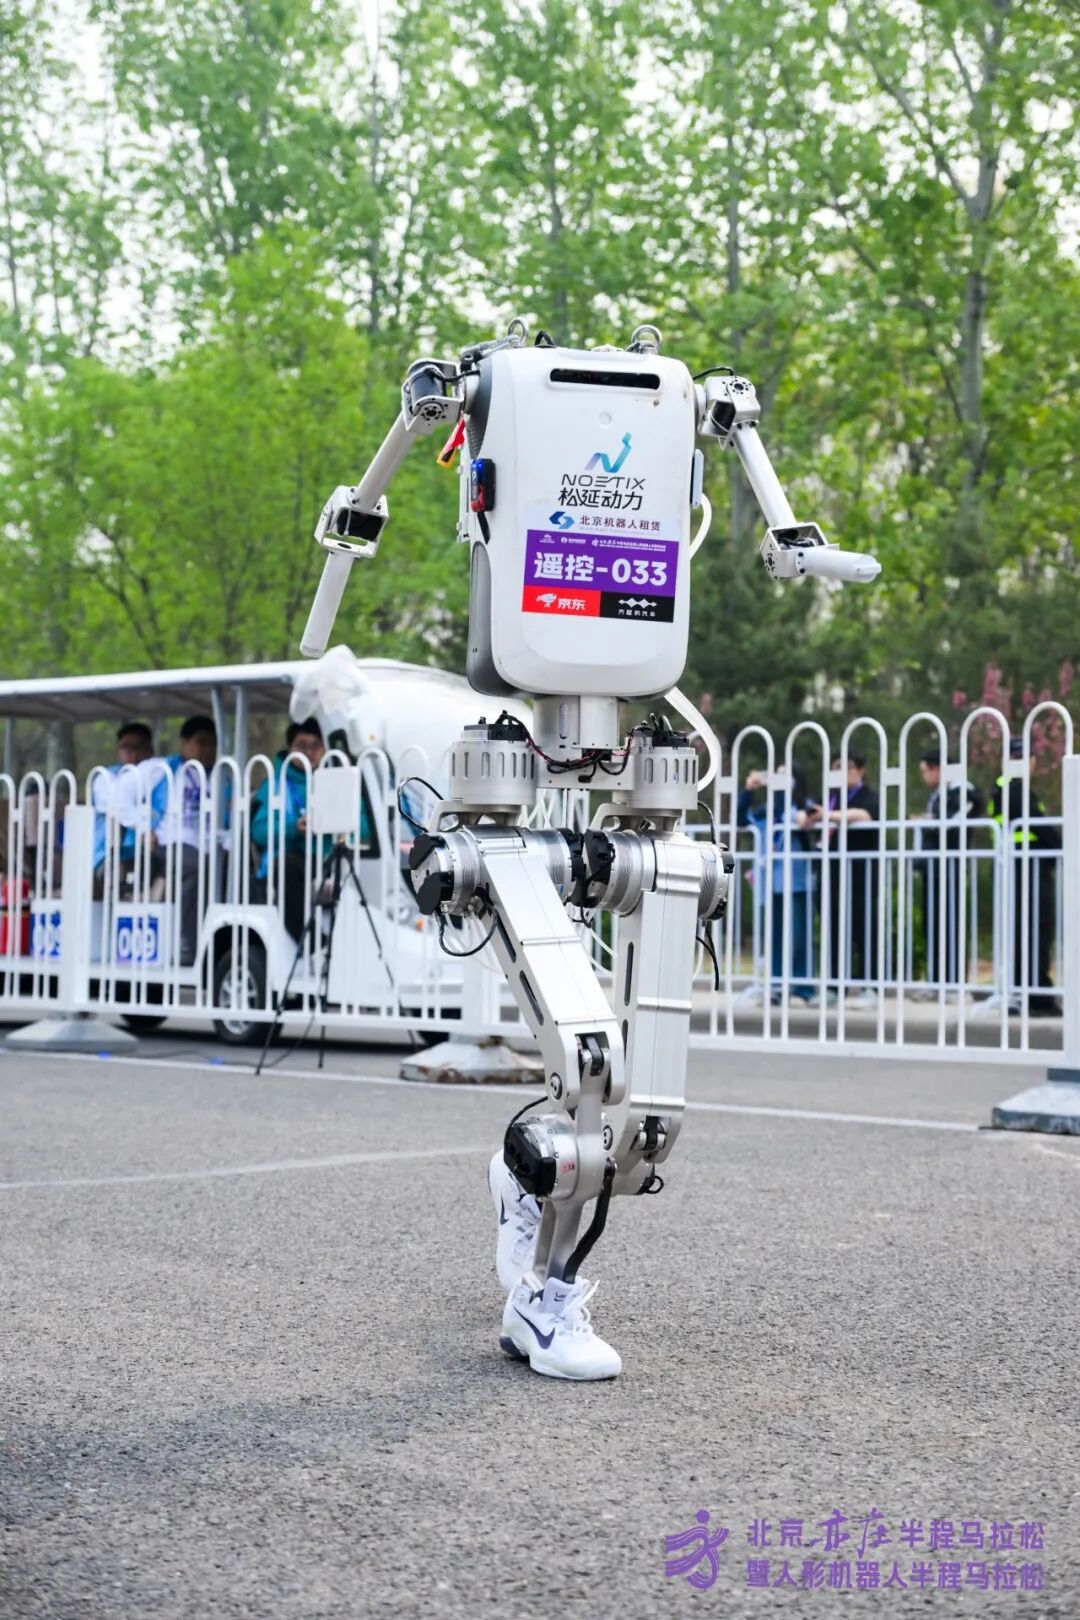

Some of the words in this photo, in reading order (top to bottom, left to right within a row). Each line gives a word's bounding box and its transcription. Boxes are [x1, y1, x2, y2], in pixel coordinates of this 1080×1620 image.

[561, 473, 646, 489] NOETIX
[558, 488, 643, 511] 松延动力
[580, 515, 661, 532] 北京机器人租赁
[533, 552, 667, 587] 遥控-033
[557, 598, 586, 611] 京东
